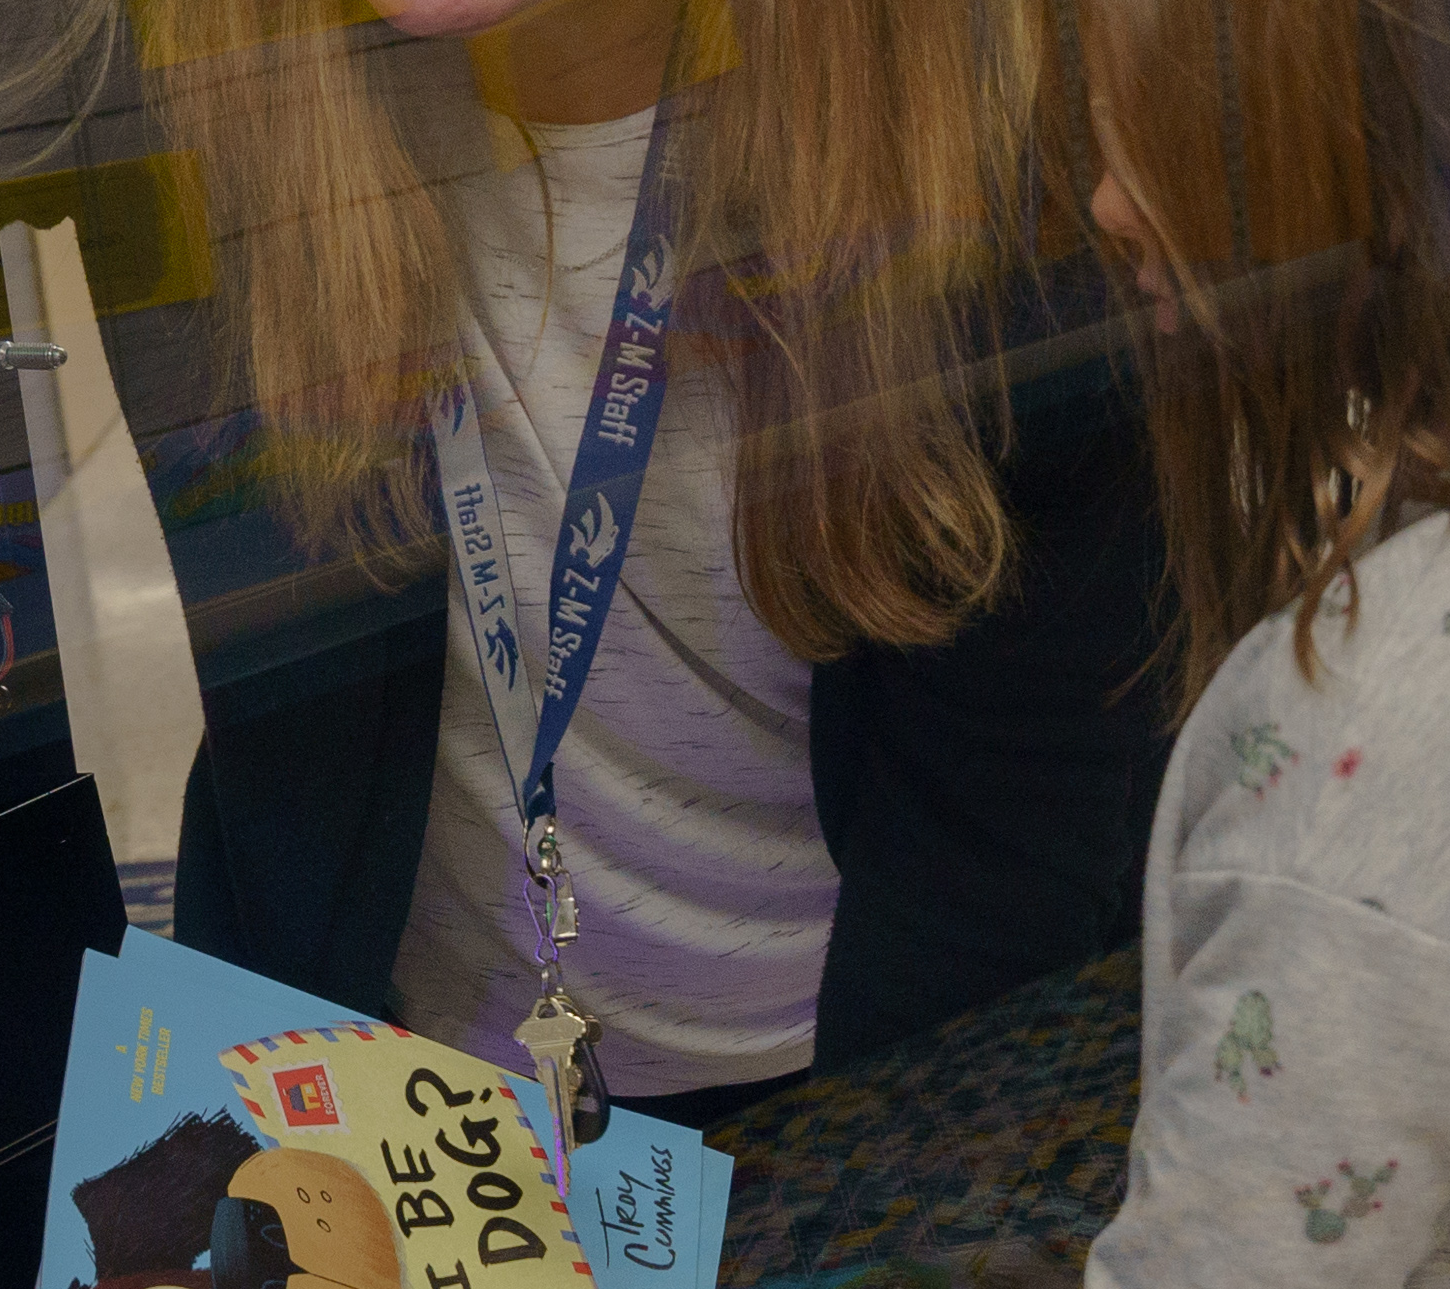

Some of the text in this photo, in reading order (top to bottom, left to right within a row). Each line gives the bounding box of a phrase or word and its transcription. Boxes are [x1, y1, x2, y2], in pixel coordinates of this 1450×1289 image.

[596, 310, 664, 449] Z-M Staff
[544, 566, 601, 702] Z-M Staff
[115, 1043, 128, 1055] A
[130, 1006, 154, 1103] NEW YORK TIMES
[151, 1026, 171, 1096] BESTSELLER
[314, 1073, 335, 1116] FOREVER
[380, 1137, 454, 1238] BE
[404, 1066, 548, 1268] DOG?
